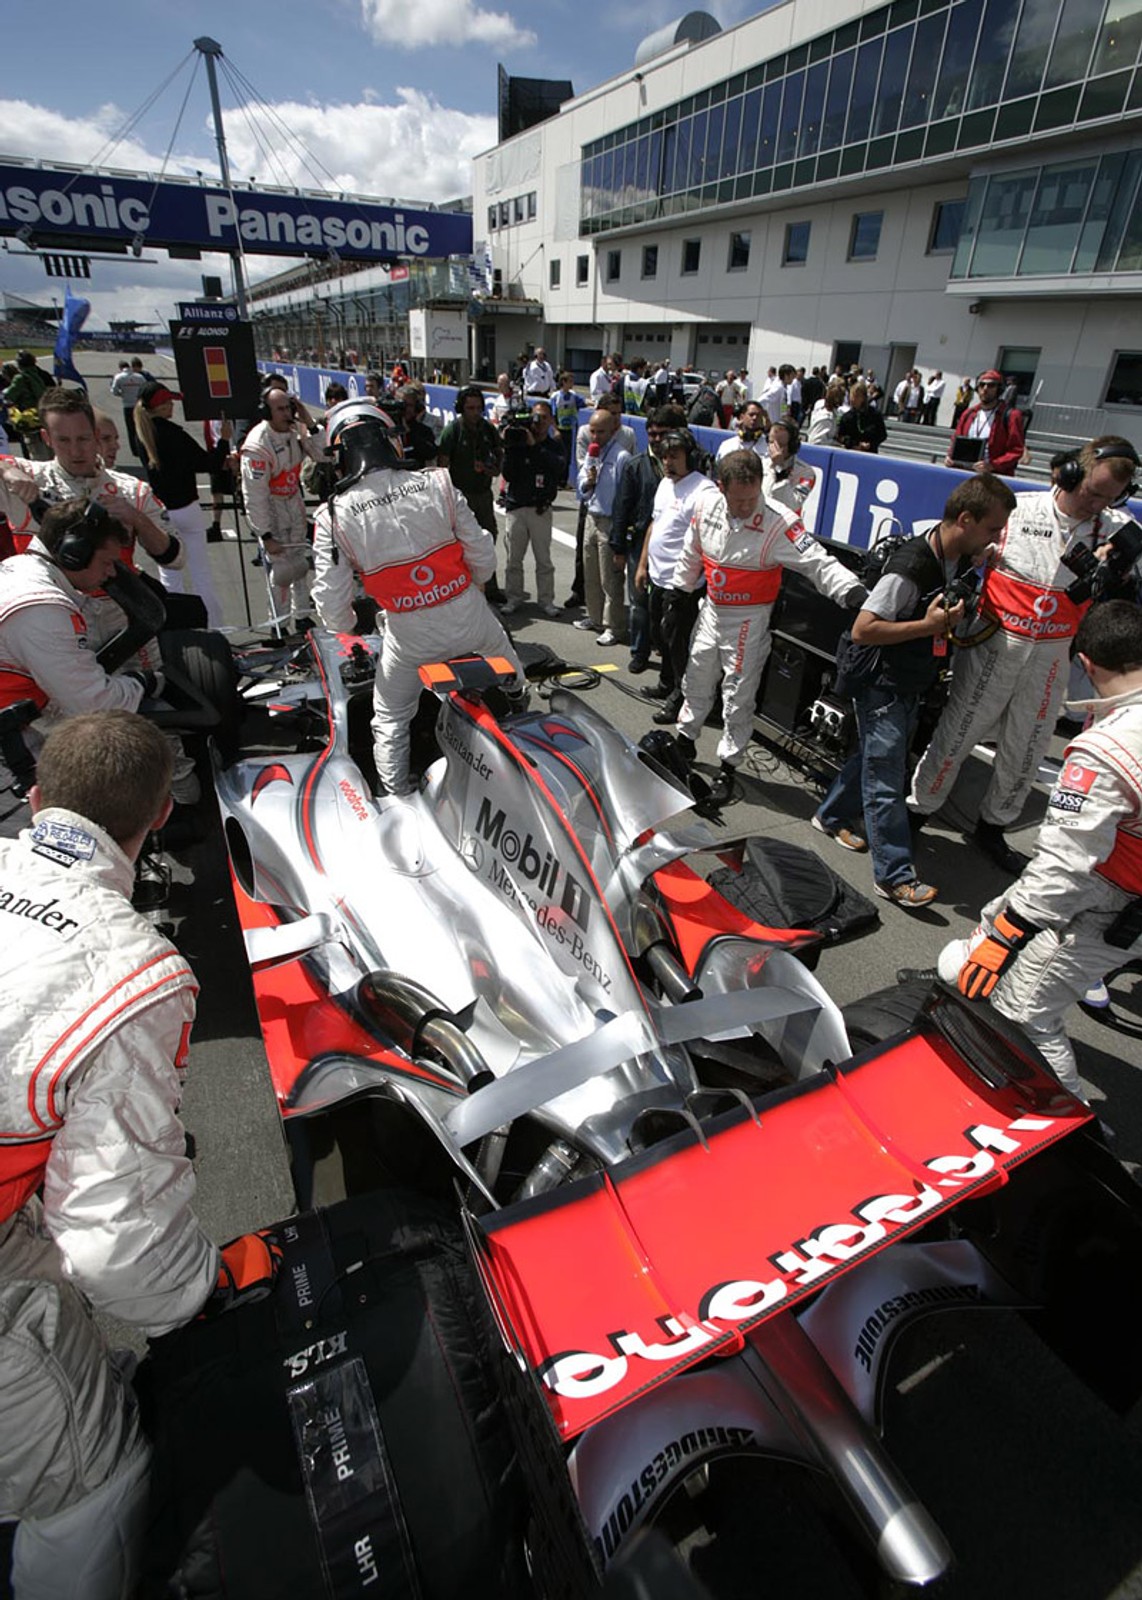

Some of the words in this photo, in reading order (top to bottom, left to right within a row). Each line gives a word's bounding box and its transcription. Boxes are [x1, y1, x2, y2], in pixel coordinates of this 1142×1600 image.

[0, 185, 150, 232] sonic
[205, 195, 430, 254] Panasonic
[184, 307, 224, 319] Allianz
[197, 327, 230, 336] ALONSO
[350, 481, 428, 516] Mercedes-Benz
[392, 574, 466, 609] vodafone
[1002, 610, 1072, 634] vodafone
[442, 730, 494, 781] Santander
[338, 778, 369, 822] vodafone
[475, 796, 560, 900] Mobil
[486, 857, 613, 995] Mercedes-Benz
[292, 1263, 314, 1308] PRIME
[854, 1283, 989, 1375] BRIDGESTONE
[324, 1406, 355, 1482] PRIME
[354, 1534, 380, 1587] LHR
